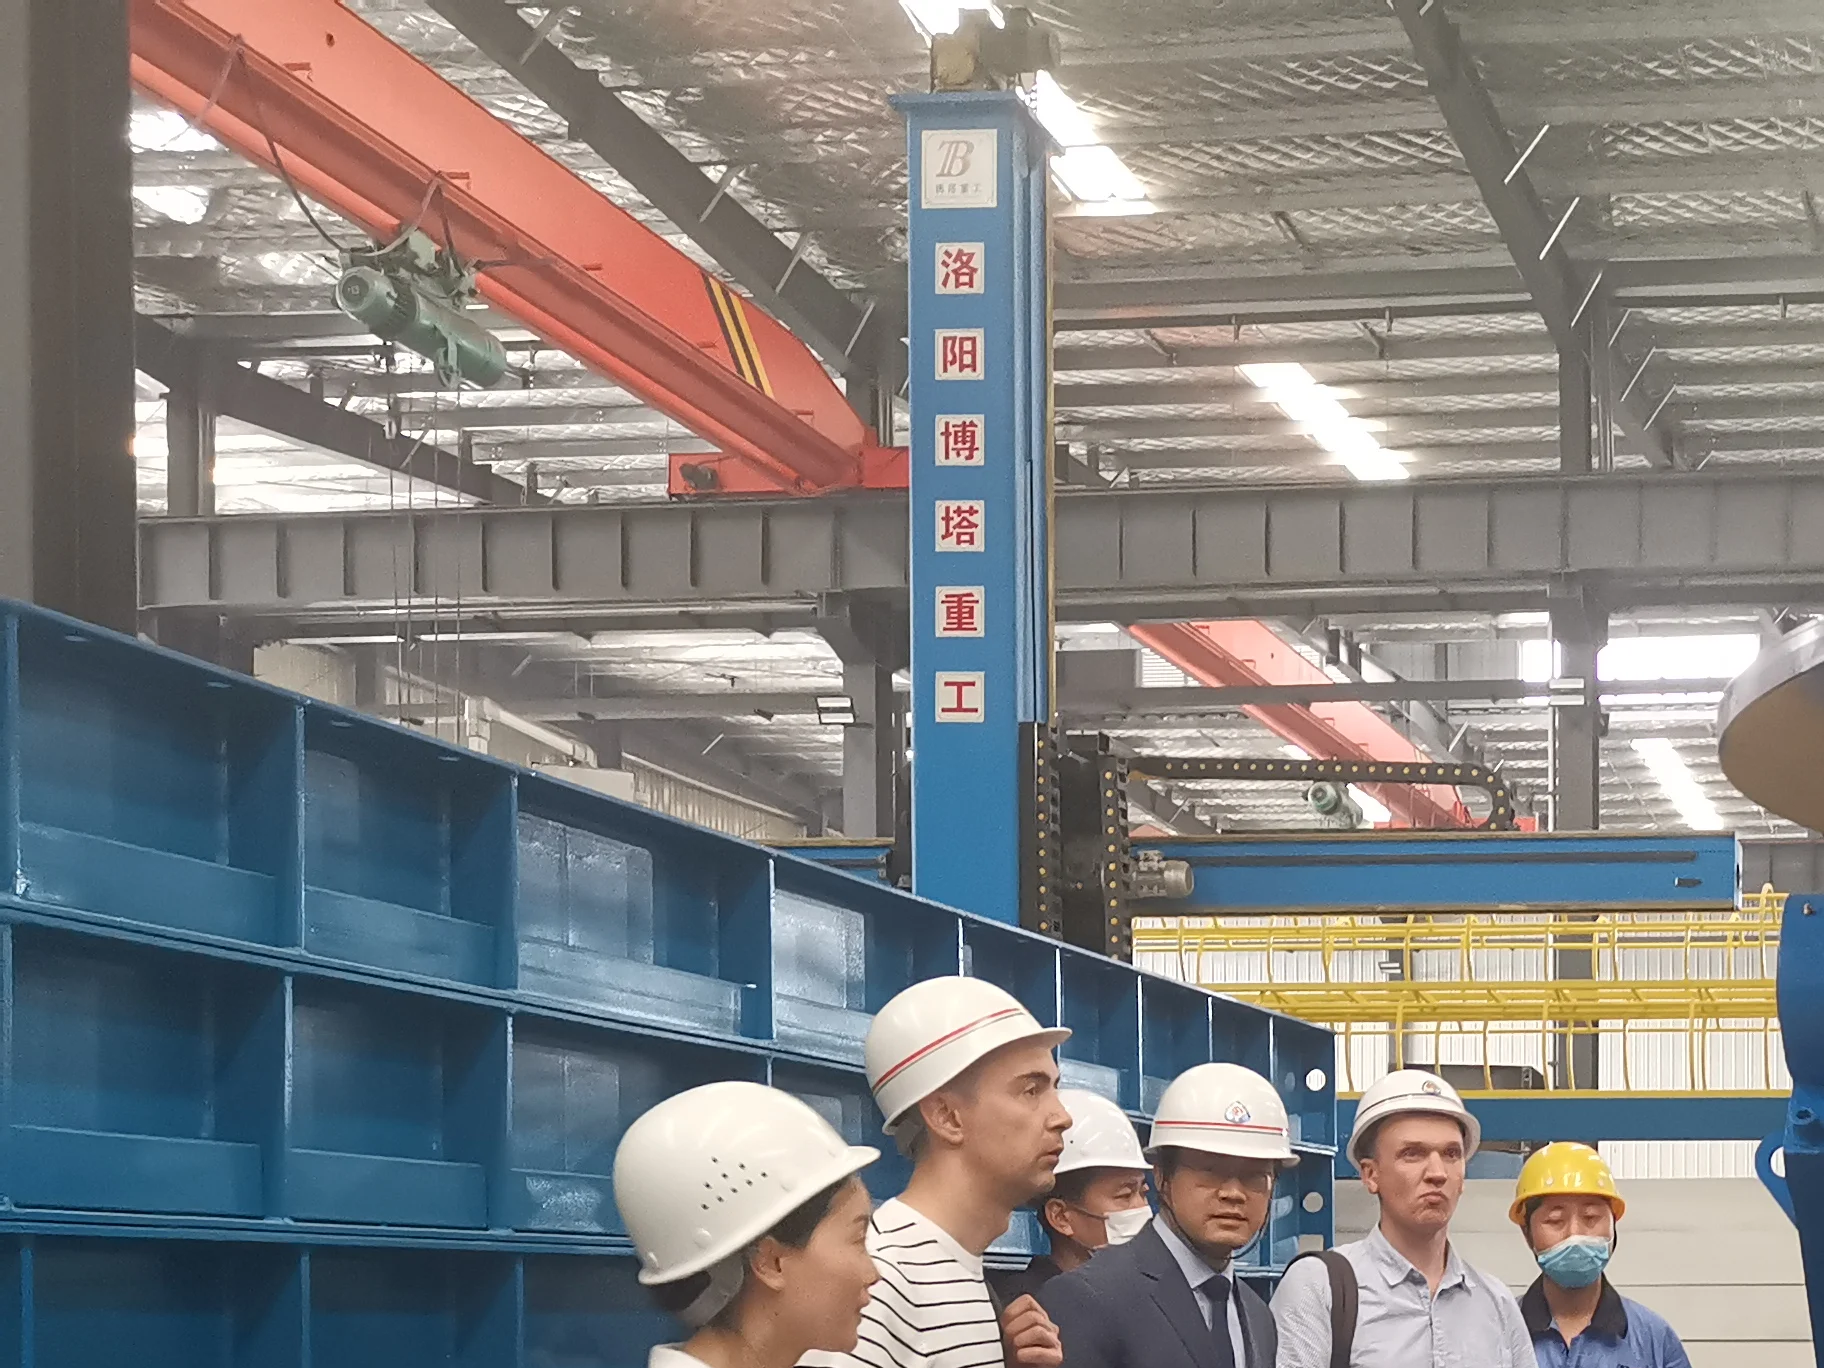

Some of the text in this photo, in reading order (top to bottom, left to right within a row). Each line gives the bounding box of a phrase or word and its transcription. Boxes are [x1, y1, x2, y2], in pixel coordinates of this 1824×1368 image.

[940, 248, 979, 713] 洛阳博塔重工
